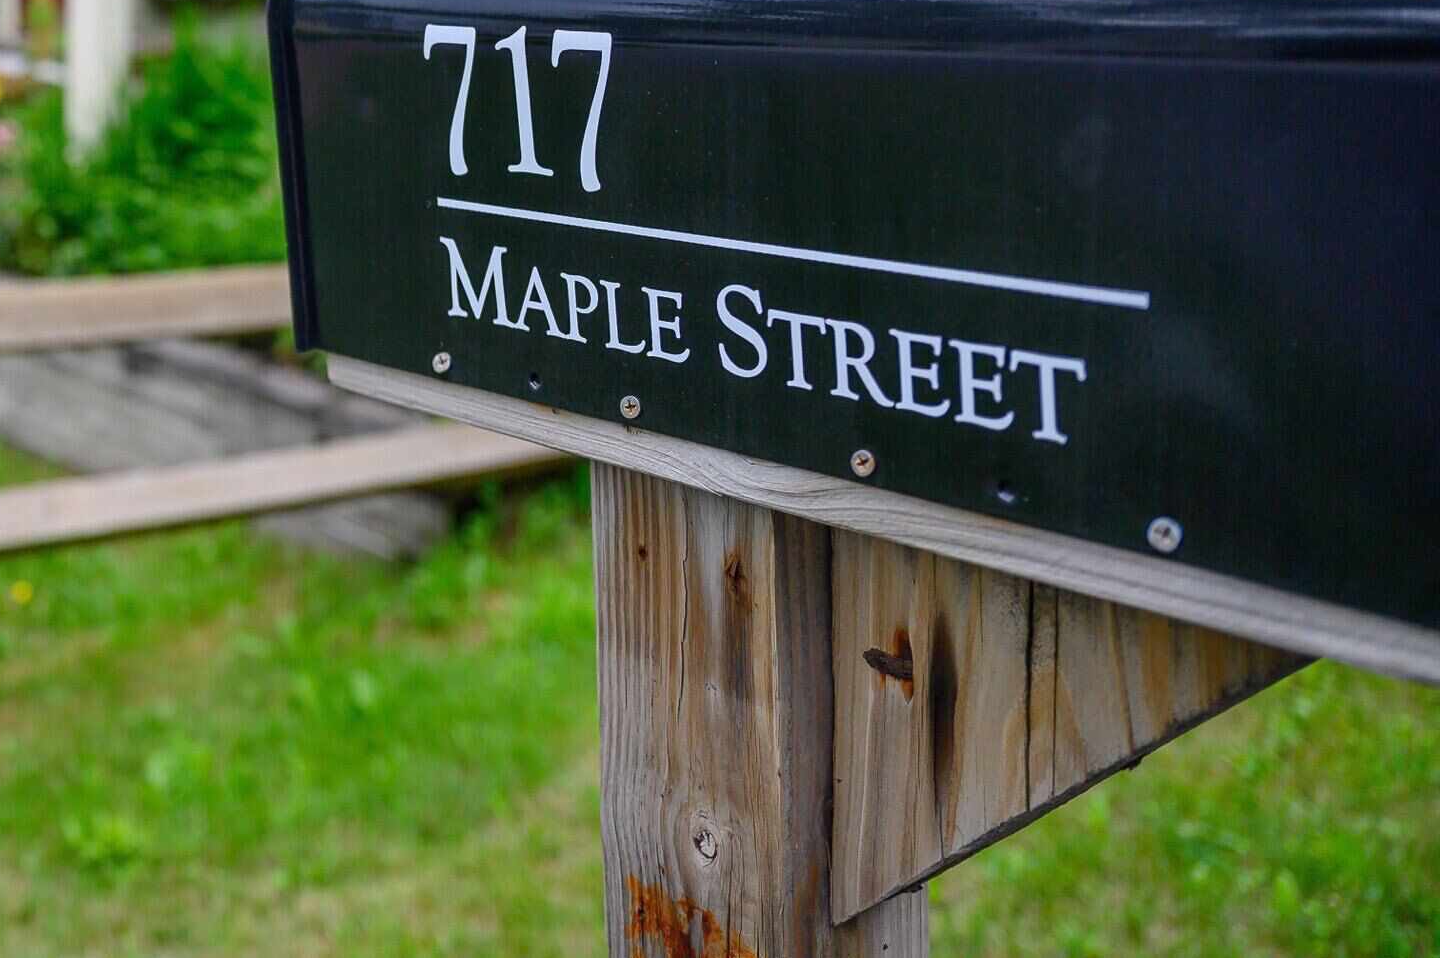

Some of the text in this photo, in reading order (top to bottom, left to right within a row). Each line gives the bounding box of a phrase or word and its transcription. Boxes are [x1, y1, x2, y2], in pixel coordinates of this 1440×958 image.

[423, 23, 612, 192] 717
[439, 236, 1087, 445] MAPLE STREET
